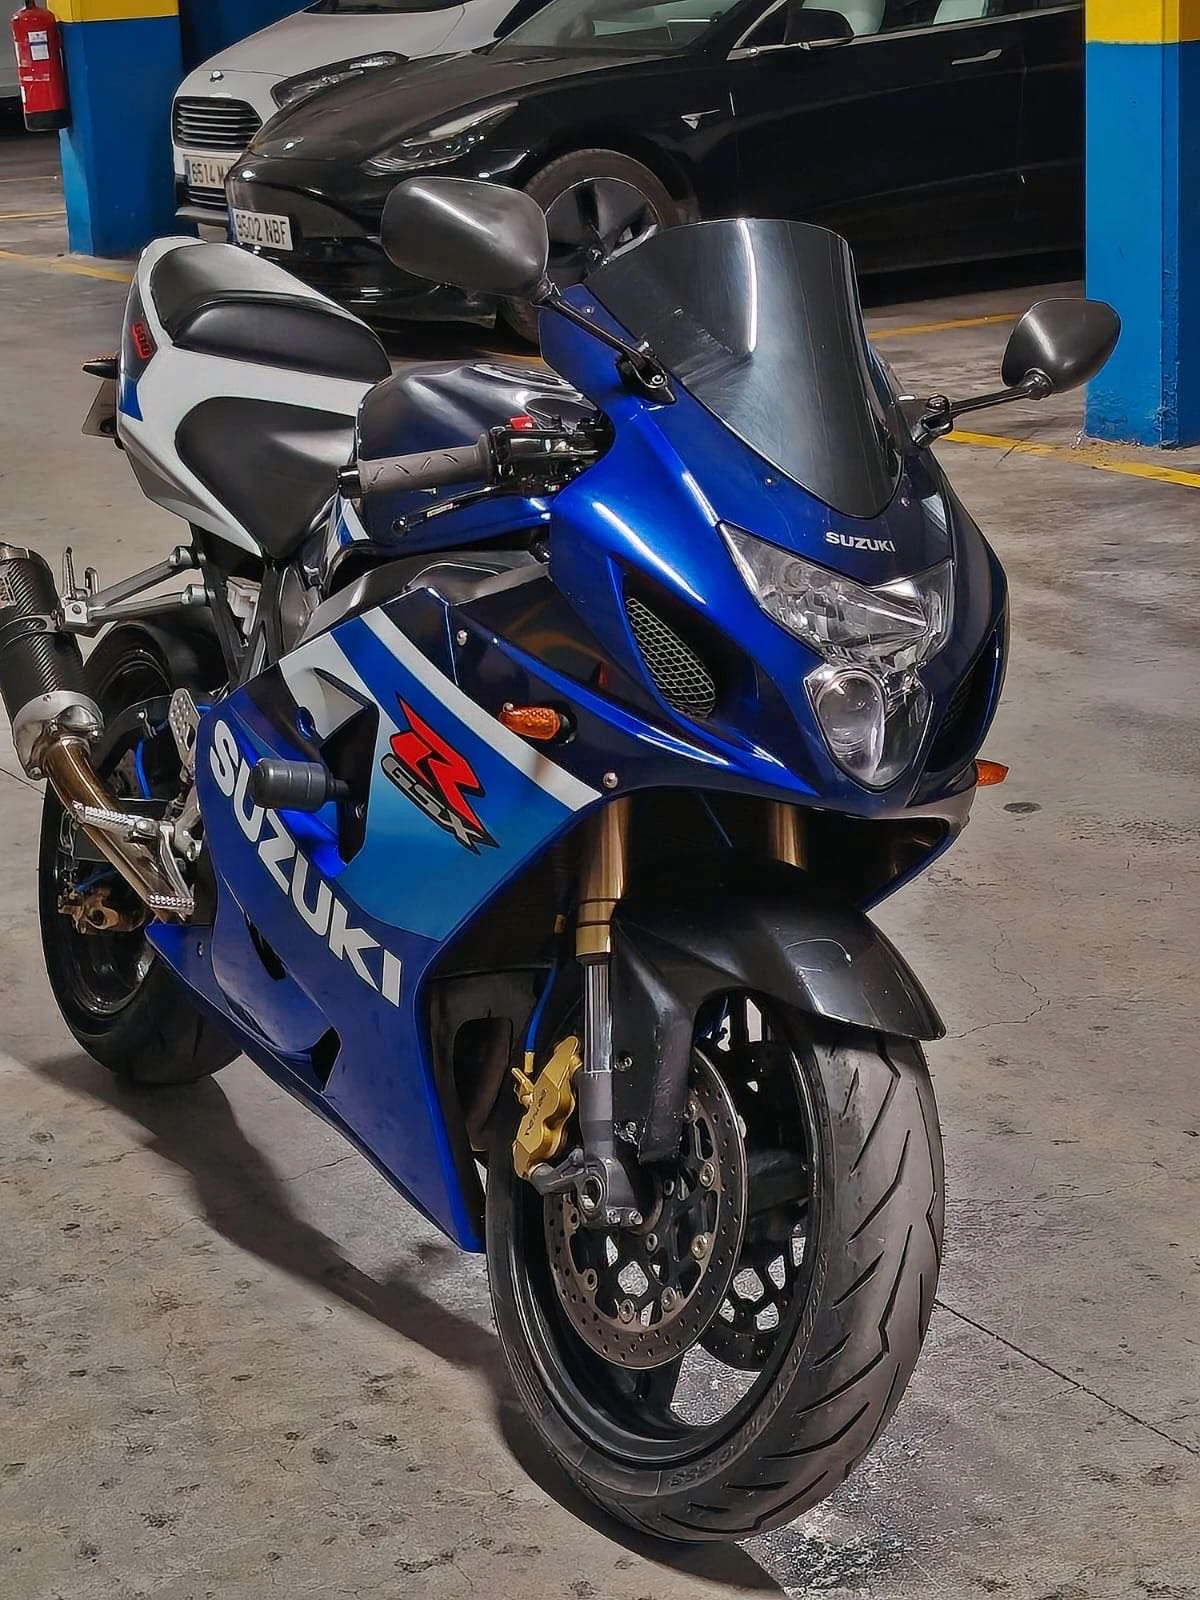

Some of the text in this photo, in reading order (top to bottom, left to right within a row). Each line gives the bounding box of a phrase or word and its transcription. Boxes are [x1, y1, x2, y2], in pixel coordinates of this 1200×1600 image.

[264, 217, 287, 245] NBF
[825, 531, 896, 552] SUZUKI
[381, 753, 484, 850] GSX
[209, 719, 402, 1008] SUZUKI
